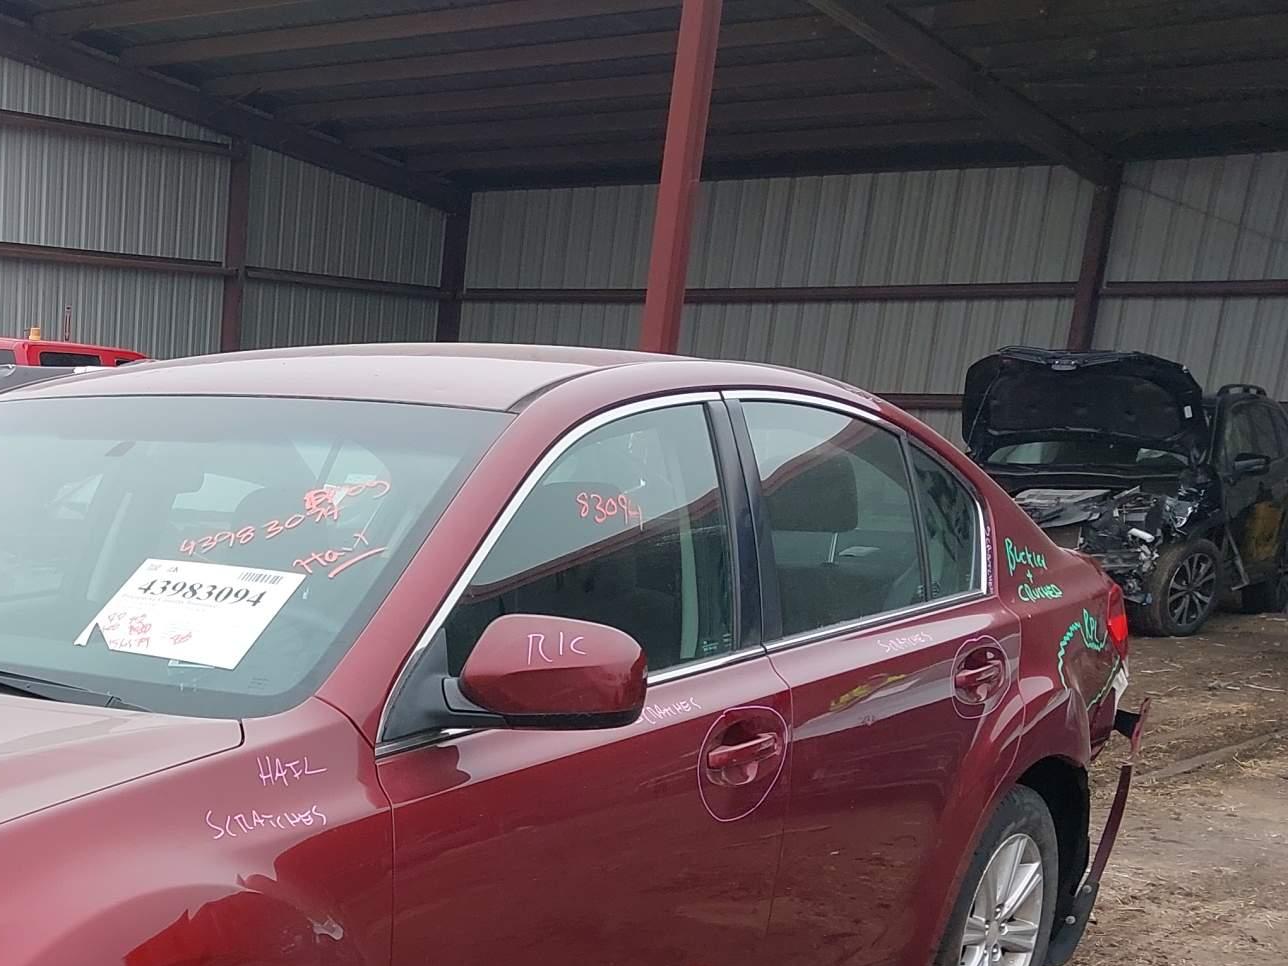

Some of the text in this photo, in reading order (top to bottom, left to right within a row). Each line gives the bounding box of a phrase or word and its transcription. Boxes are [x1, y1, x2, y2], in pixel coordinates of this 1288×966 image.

[576, 491, 644, 532] 83094
[137, 578, 267, 608] 43983094
[256, 755, 328, 787] HAIL
[205, 804, 328, 840] SCRATCHES
